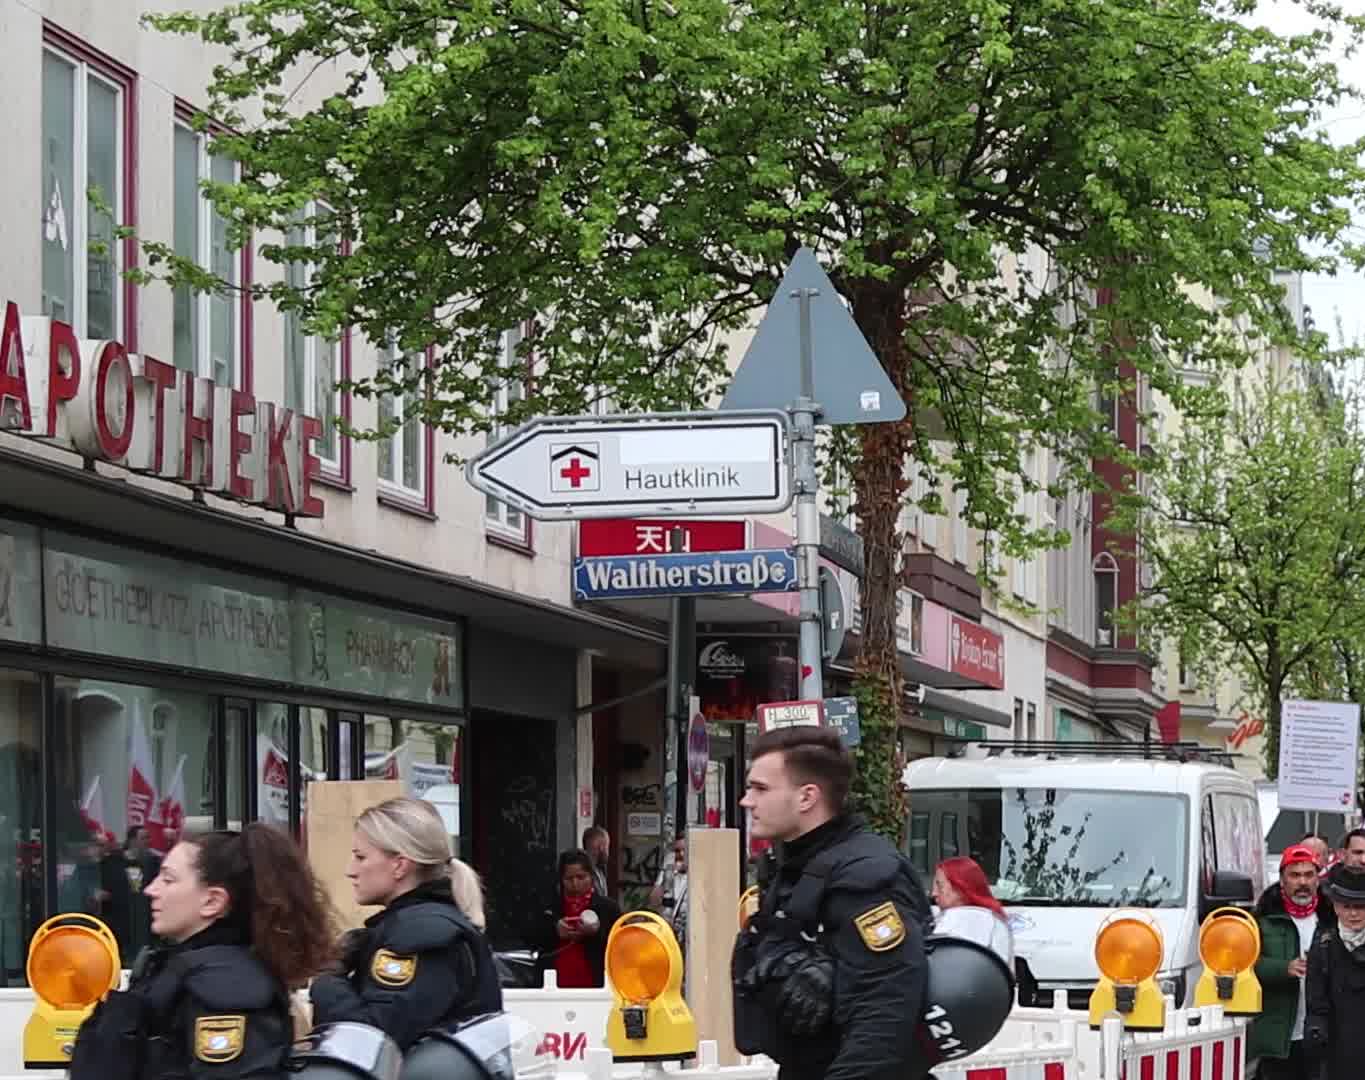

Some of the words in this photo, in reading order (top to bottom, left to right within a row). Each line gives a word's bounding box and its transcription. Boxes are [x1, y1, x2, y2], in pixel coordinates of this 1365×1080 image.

[0, 300, 324, 518] APOTHEKE
[624, 467, 740, 489] Hautklinik
[586, 553, 786, 592] Waltherstraße
[925, 1004, 968, 1058] 1211
